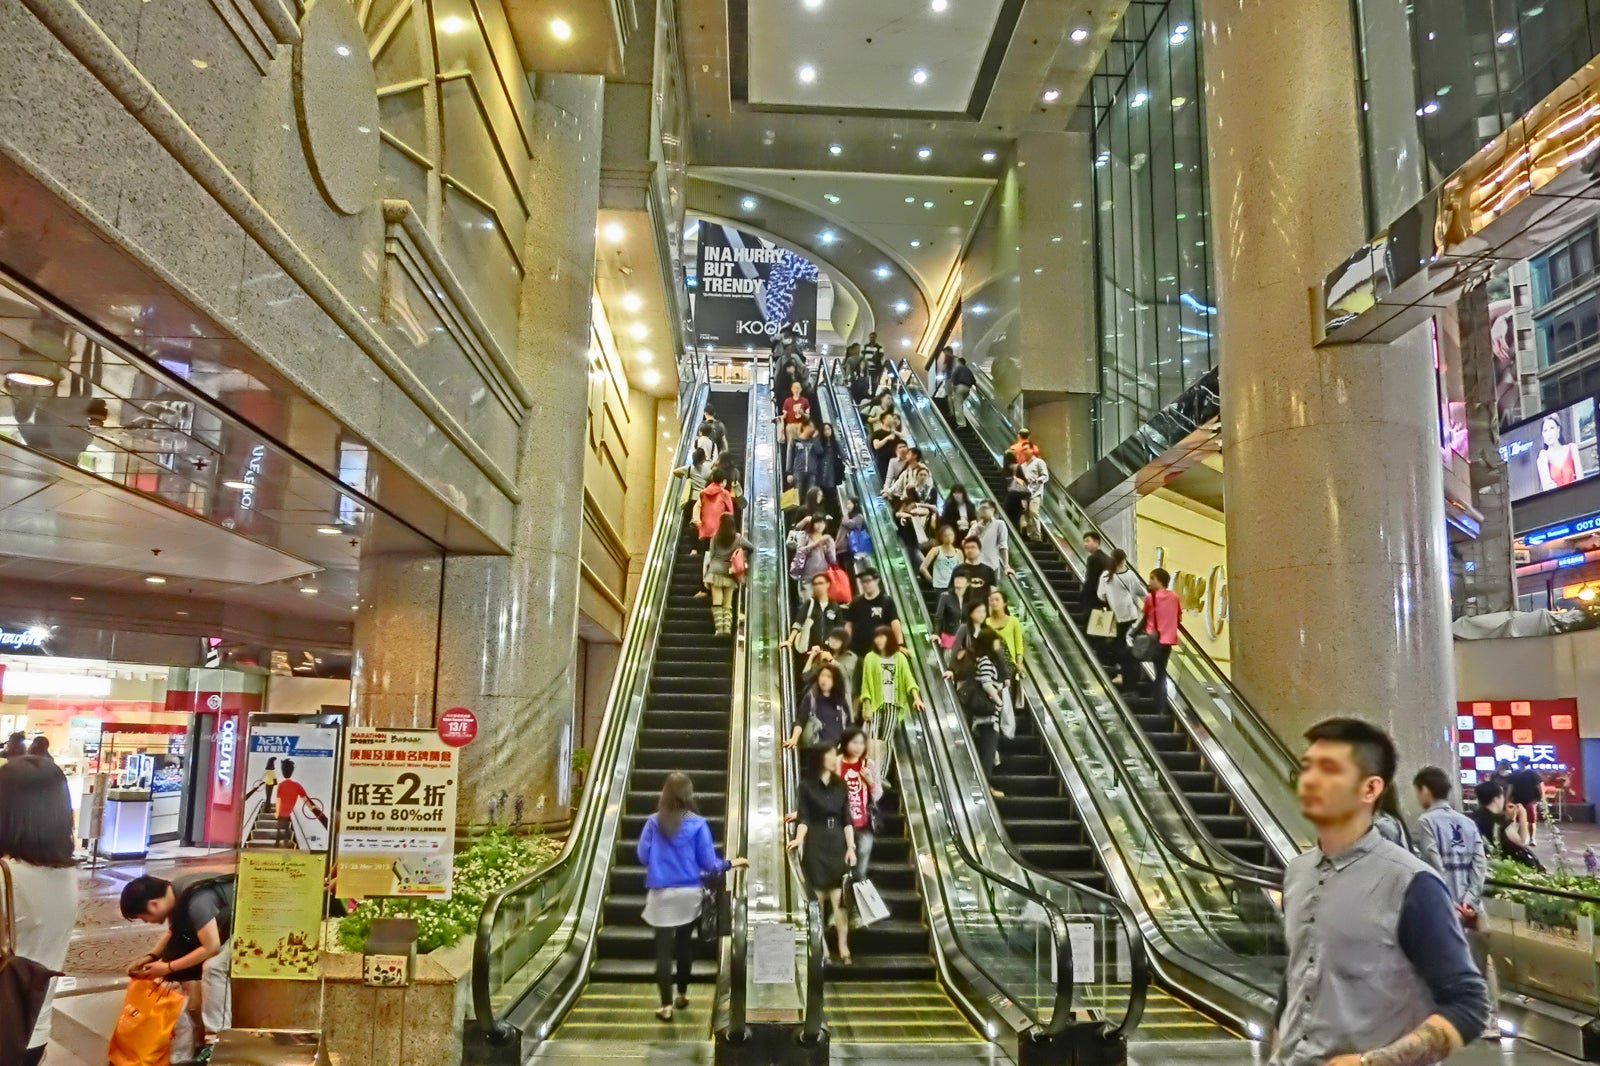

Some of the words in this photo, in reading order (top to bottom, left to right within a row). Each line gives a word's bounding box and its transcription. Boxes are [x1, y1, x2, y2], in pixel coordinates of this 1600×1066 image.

[734, 247, 784, 264] HURRY
[704, 262, 734, 277] BUT
[703, 278, 765, 294] TRENDY
[218, 720, 234, 786] SHISEIDO
[347, 811, 366, 823] up
[371, 810, 386, 820] to
